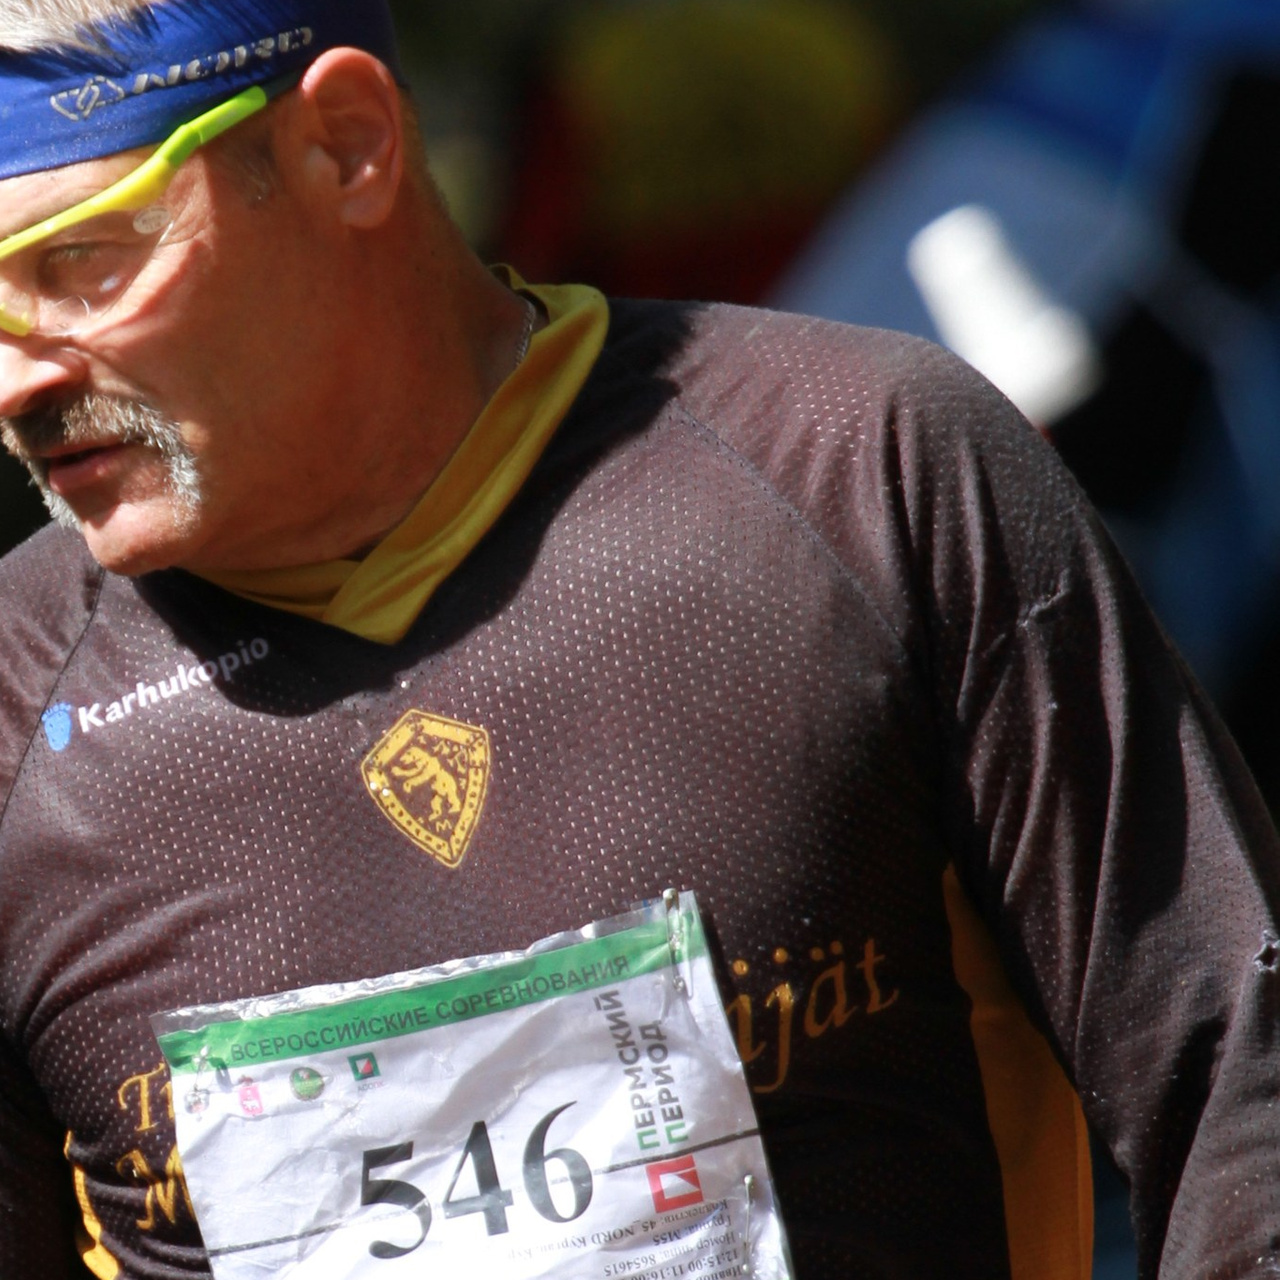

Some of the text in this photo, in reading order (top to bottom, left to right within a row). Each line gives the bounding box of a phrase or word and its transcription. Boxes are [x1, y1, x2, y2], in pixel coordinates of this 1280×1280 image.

[77, 637, 270, 733] Karhukopio
[230, 955, 630, 1062] ВСЕРОССИЙСКИЕ СОРЕВНОВАНИЯ
[593, 989, 660, 1151] ПЕРМСКИЙ
[638, 1019, 689, 1145] ПЕРИОД
[361, 1100, 593, 1259] 546
[603, 1253, 657, 1277] 8654615
